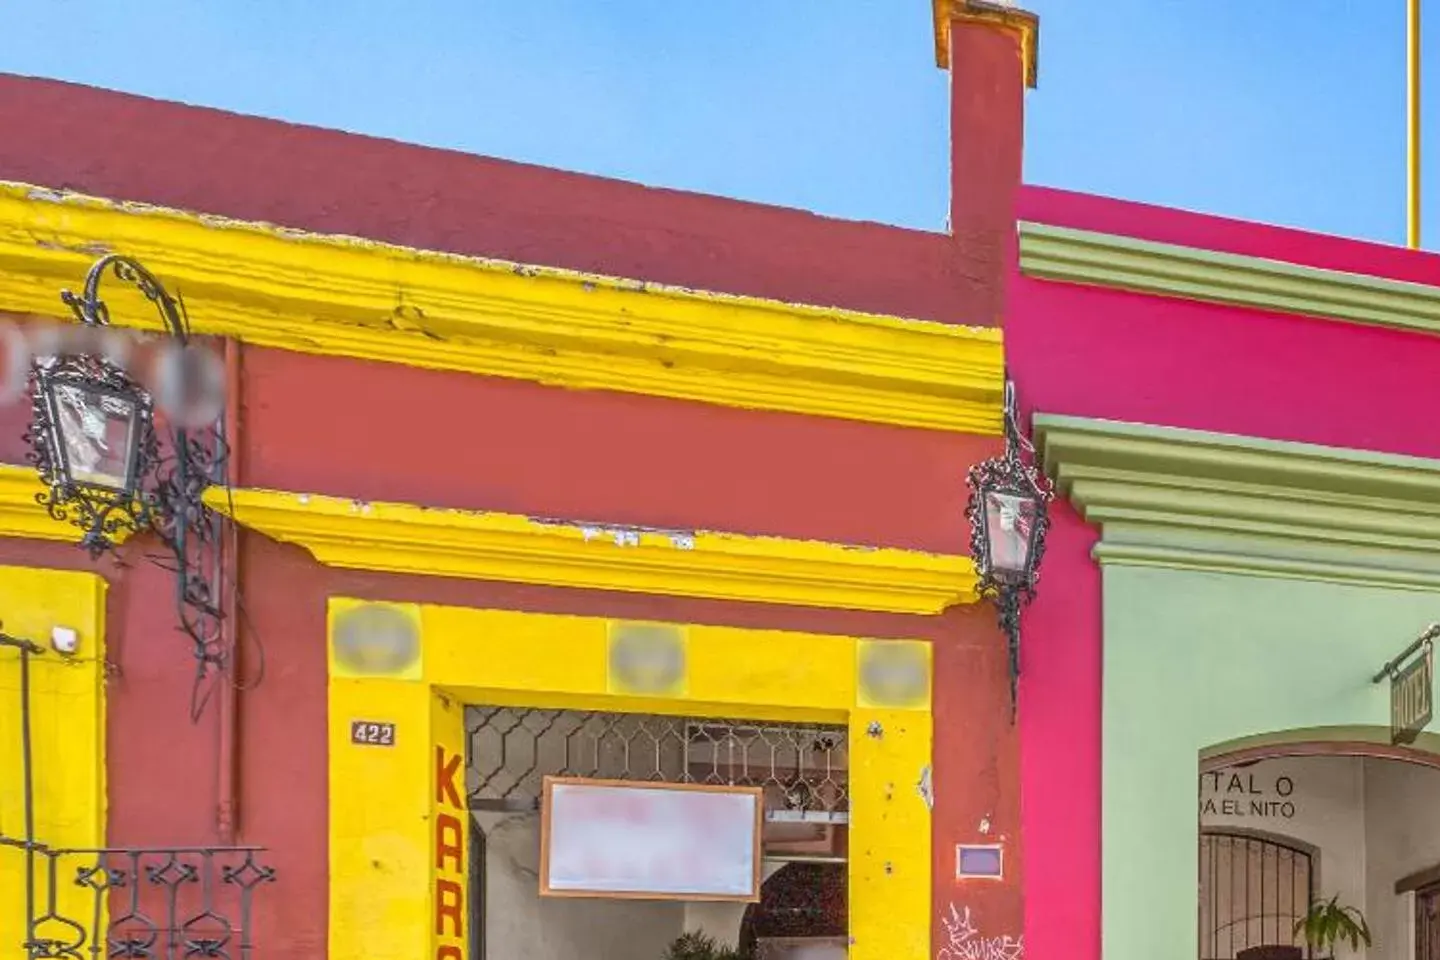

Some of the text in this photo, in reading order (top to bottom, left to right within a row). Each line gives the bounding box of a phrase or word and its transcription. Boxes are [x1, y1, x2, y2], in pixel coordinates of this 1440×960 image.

[354, 723, 393, 744] 422
[1275, 776, 1294, 797] O
[1222, 800, 1245, 816] EL
[1249, 800, 1295, 819] NITO
